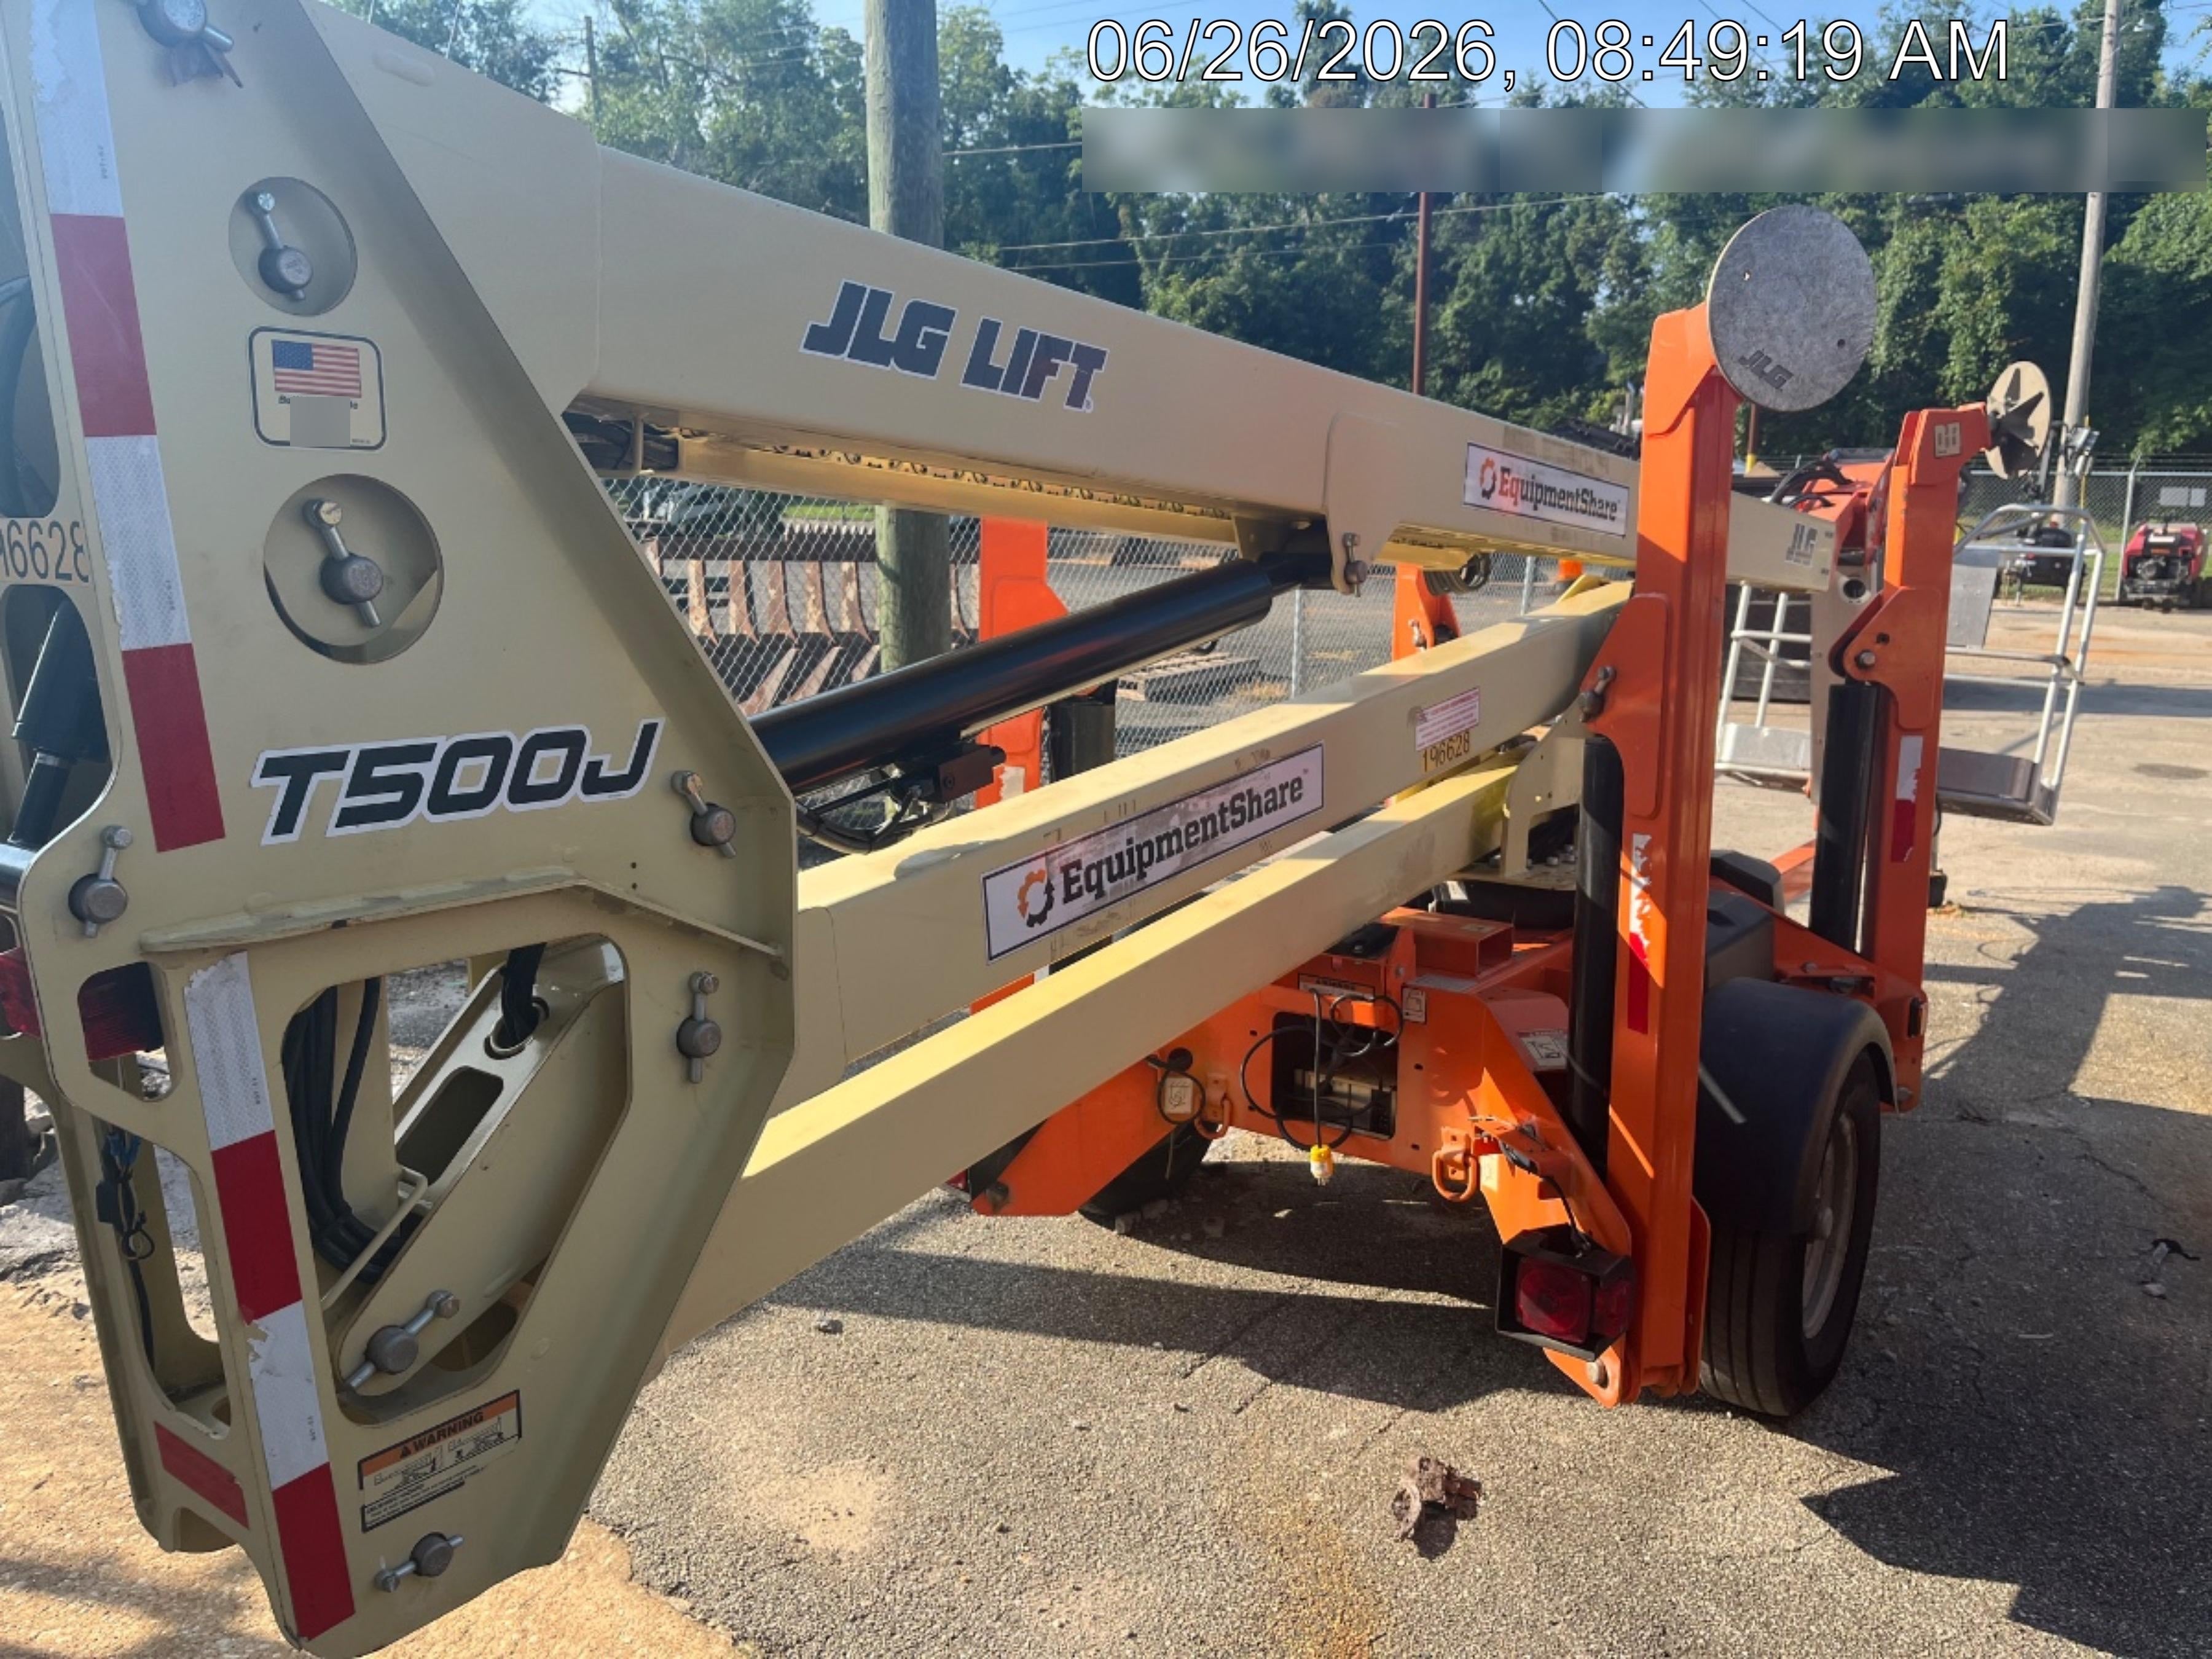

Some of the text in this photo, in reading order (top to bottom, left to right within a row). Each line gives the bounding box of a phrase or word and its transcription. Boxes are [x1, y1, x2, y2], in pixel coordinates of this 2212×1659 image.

[799, 279, 1108, 412] JLG LIFT
[1738, 350, 1794, 390] JLG
[1498, 466, 1617, 521] EquipmentShare
[1422, 729, 1470, 772] 196628
[251, 718, 664, 844] T500J
[1060, 776, 1304, 904] EquipmentShare
[414, 1412, 484, 1452] WARNING
